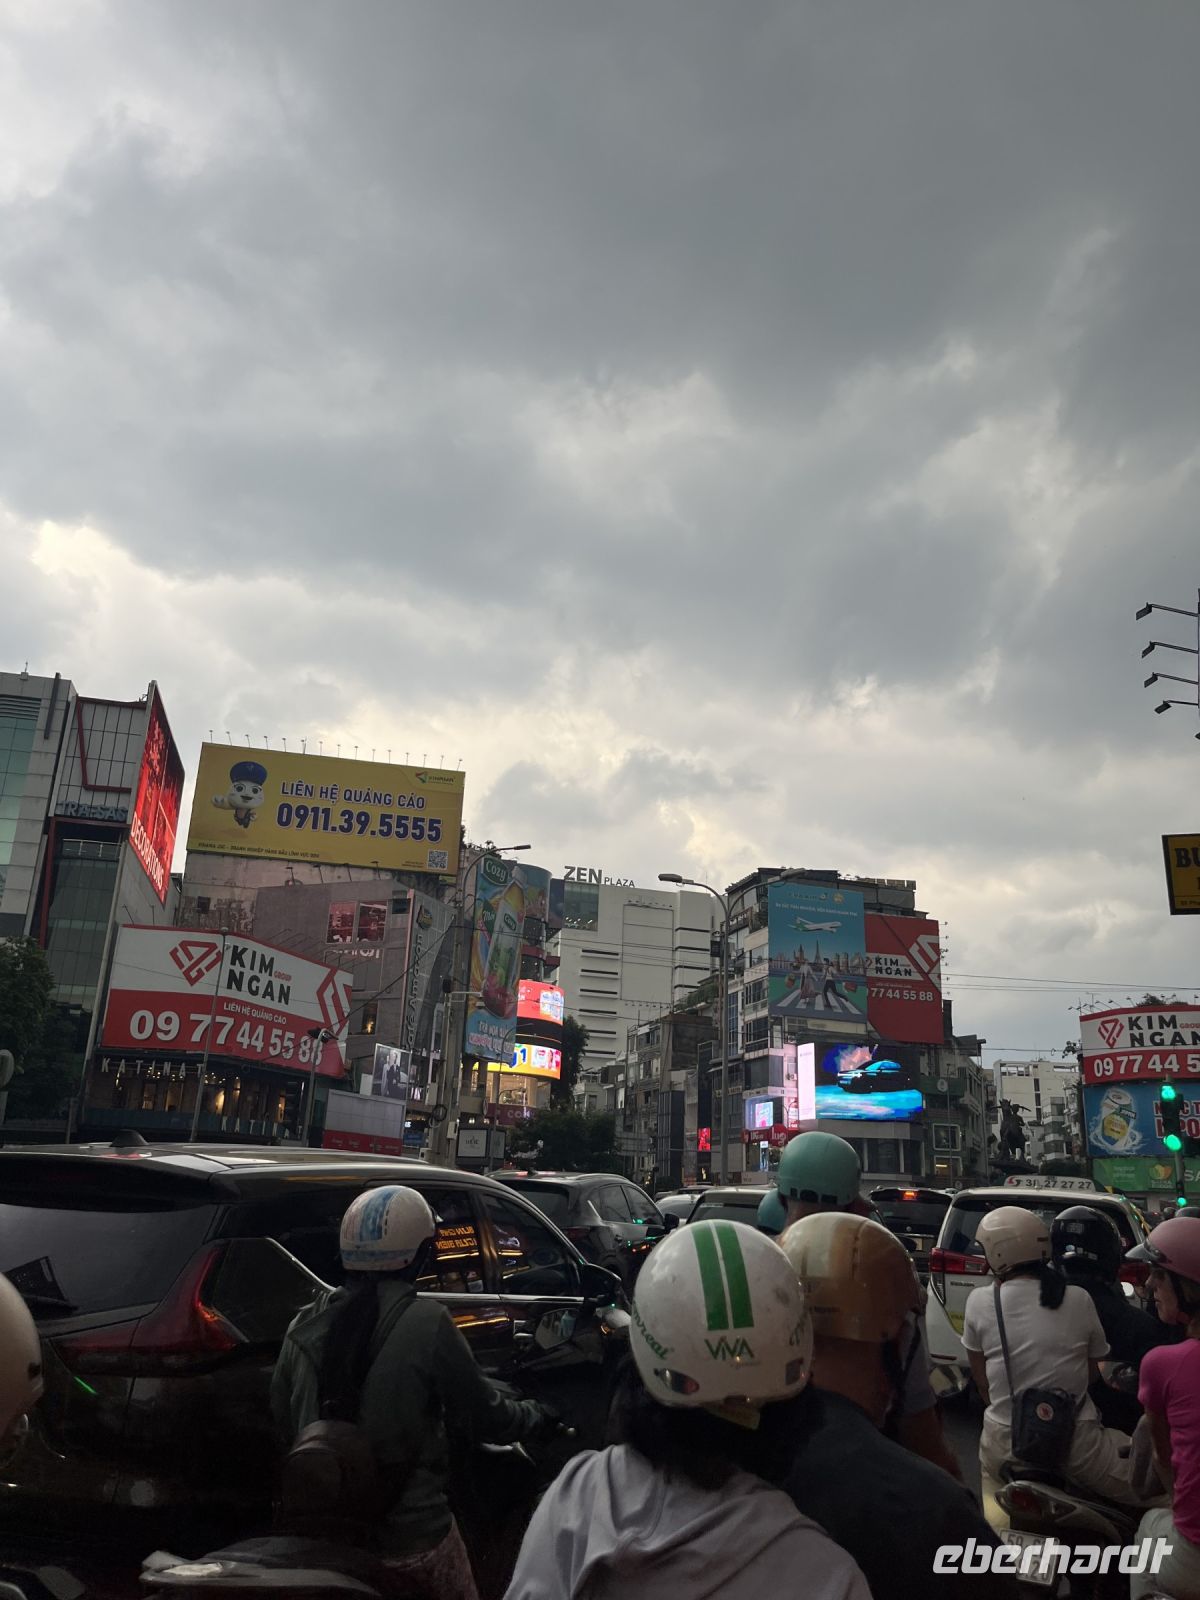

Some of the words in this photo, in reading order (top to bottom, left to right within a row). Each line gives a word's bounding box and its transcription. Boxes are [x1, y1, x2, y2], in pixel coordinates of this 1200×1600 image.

[281, 780, 314, 798] LIÊN
[319, 784, 339, 803] HỆ
[343, 787, 392, 807] QUẢNG
[397, 792, 426, 810] CÁO
[276, 802, 443, 842] 0911.39.5555
[131, 811, 164, 890] DECORATIONS
[485, 859, 508, 881] Cozy
[564, 865, 602, 884] ZEN
[604, 876, 636, 888] PLAZA
[230, 945, 275, 977] KIM
[874, 955, 899, 967] KIM
[874, 966, 912, 977] NGAN
[226, 969, 291, 1005] NGAN
[871, 987, 884, 998] 77
[885, 988, 900, 999] 44
[902, 989, 917, 1000] 55
[919, 991, 934, 1001] 88
[223, 1002, 241, 1013] LIÊN
[1128, 1014, 1178, 1031] KIM
[129, 1009, 180, 1042] 09
[189, 1013, 235, 1045] 77
[236, 1021, 265, 1053] 44
[269, 1029, 295, 1060] 55
[101, 1057, 205, 1078] KATINAT
[1094, 1057, 1114, 1077] 09
[1116, 1055, 1143, 1074] 77
[1147, 1054, 1180, 1072] 44
[1061, 1181, 1074, 1189] 27
[1078, 1181, 1092, 1189] 27
[704, 1336, 755, 1361] VIVA
